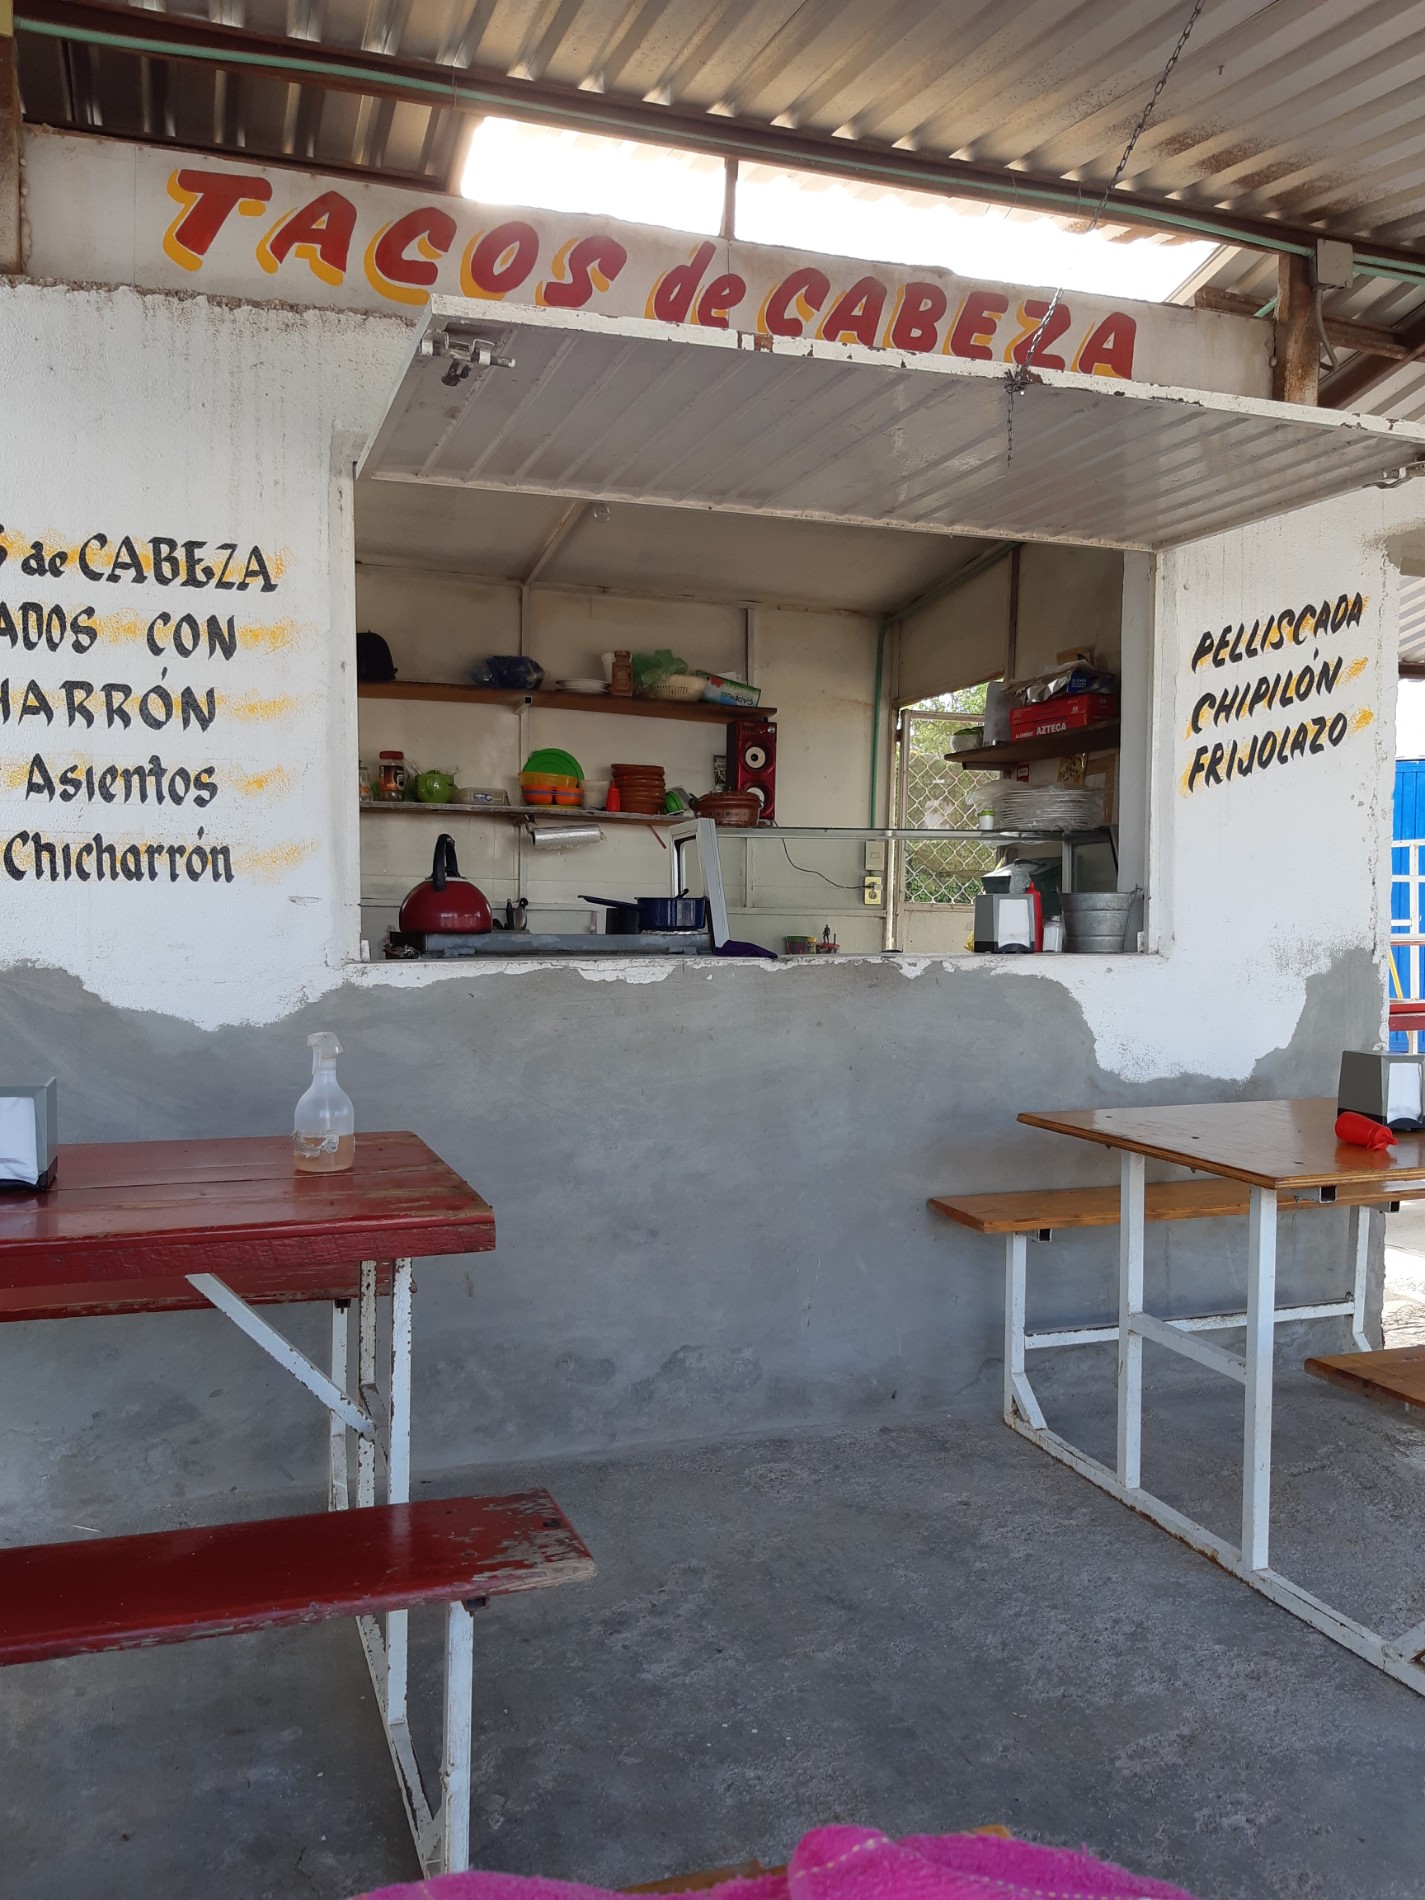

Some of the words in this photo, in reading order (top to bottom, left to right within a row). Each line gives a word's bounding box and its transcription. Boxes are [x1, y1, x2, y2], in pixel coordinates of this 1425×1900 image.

[164, 168, 628, 310] TACOS
[646, 241, 747, 329] de
[758, 267, 1137, 380] CABEZA
[21, 540, 69, 578] de
[78, 532, 279, 593] CABEZA
[146, 611, 237, 661] CON
[1191, 592, 1363, 675] PELLISCADA
[1191, 647, 1344, 734] CHIPILÓN
[1036, 722, 1067, 736] AZTECA
[1188, 712, 1348, 793] FRIJOLAZO
[25, 753, 218, 808] Asientos
[3, 826, 235, 883] Chicharrón
